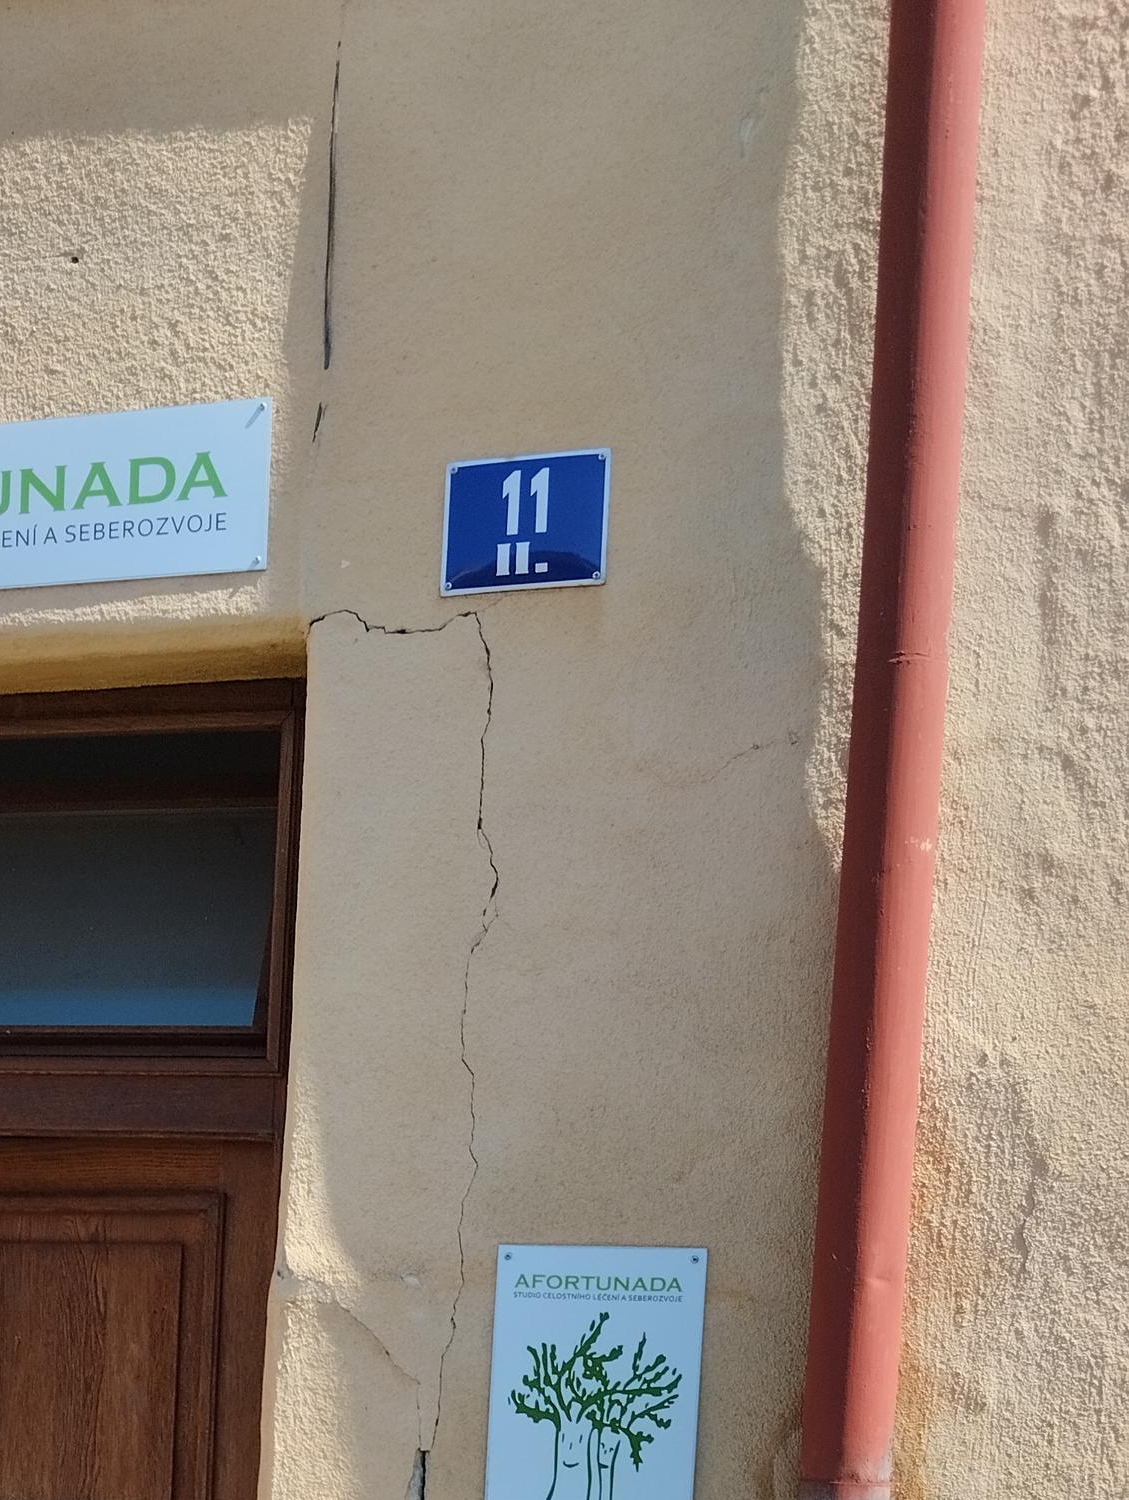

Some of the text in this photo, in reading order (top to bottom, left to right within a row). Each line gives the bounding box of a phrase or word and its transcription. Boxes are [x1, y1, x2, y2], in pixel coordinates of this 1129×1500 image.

[502, 467, 550, 536] 11
[44, 525, 58, 543] A
[64, 512, 227, 544] SEBEROZVOJE
[514, 1274, 682, 1292] AFORTUNADA
[513, 1291, 542, 1299] STUDIO
[543, 1292, 591, 1301] CELOSTNÍHO
[628, 1294, 683, 1303] SEBEROZVOJE
